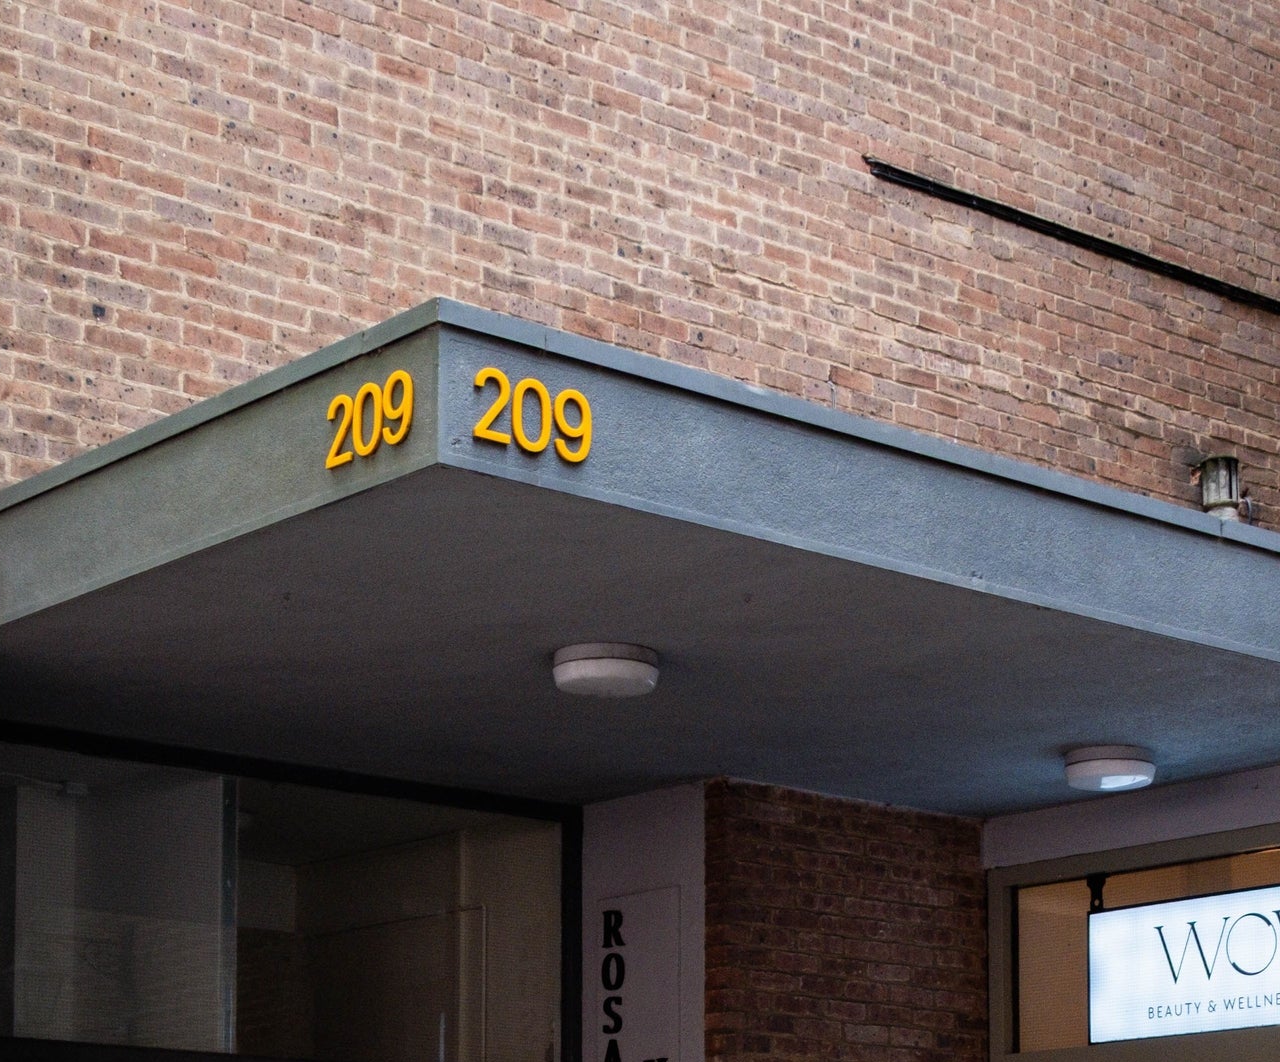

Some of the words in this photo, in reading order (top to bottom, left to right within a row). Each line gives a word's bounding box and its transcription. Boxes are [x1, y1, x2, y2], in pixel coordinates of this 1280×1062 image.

[325, 369, 414, 470] 209
[473, 366, 593, 463] 209
[1147, 1001, 1203, 1020] BEAUTY
[1207, 999, 1217, 1014] &
